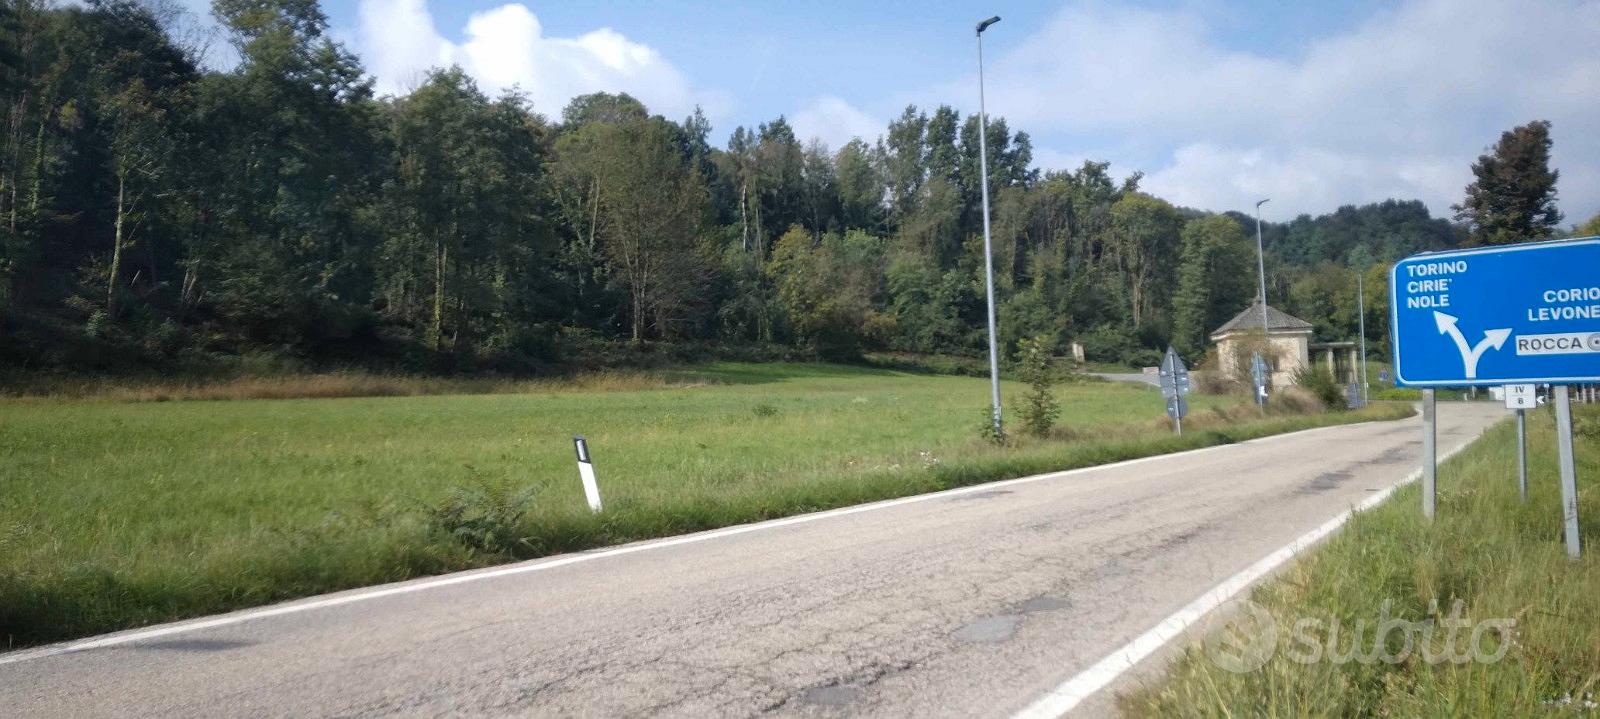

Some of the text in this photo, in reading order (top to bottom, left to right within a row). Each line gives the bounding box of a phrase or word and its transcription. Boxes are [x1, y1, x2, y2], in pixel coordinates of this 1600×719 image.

[1407, 260, 1467, 277] TORINO
[1407, 278, 1452, 293] CIRIE'
[1407, 294, 1450, 308] NOLE
[1543, 287, 1600, 303] CORIO
[1528, 304, 1600, 321] LEVONE
[1518, 337, 1583, 351] ROCCA
